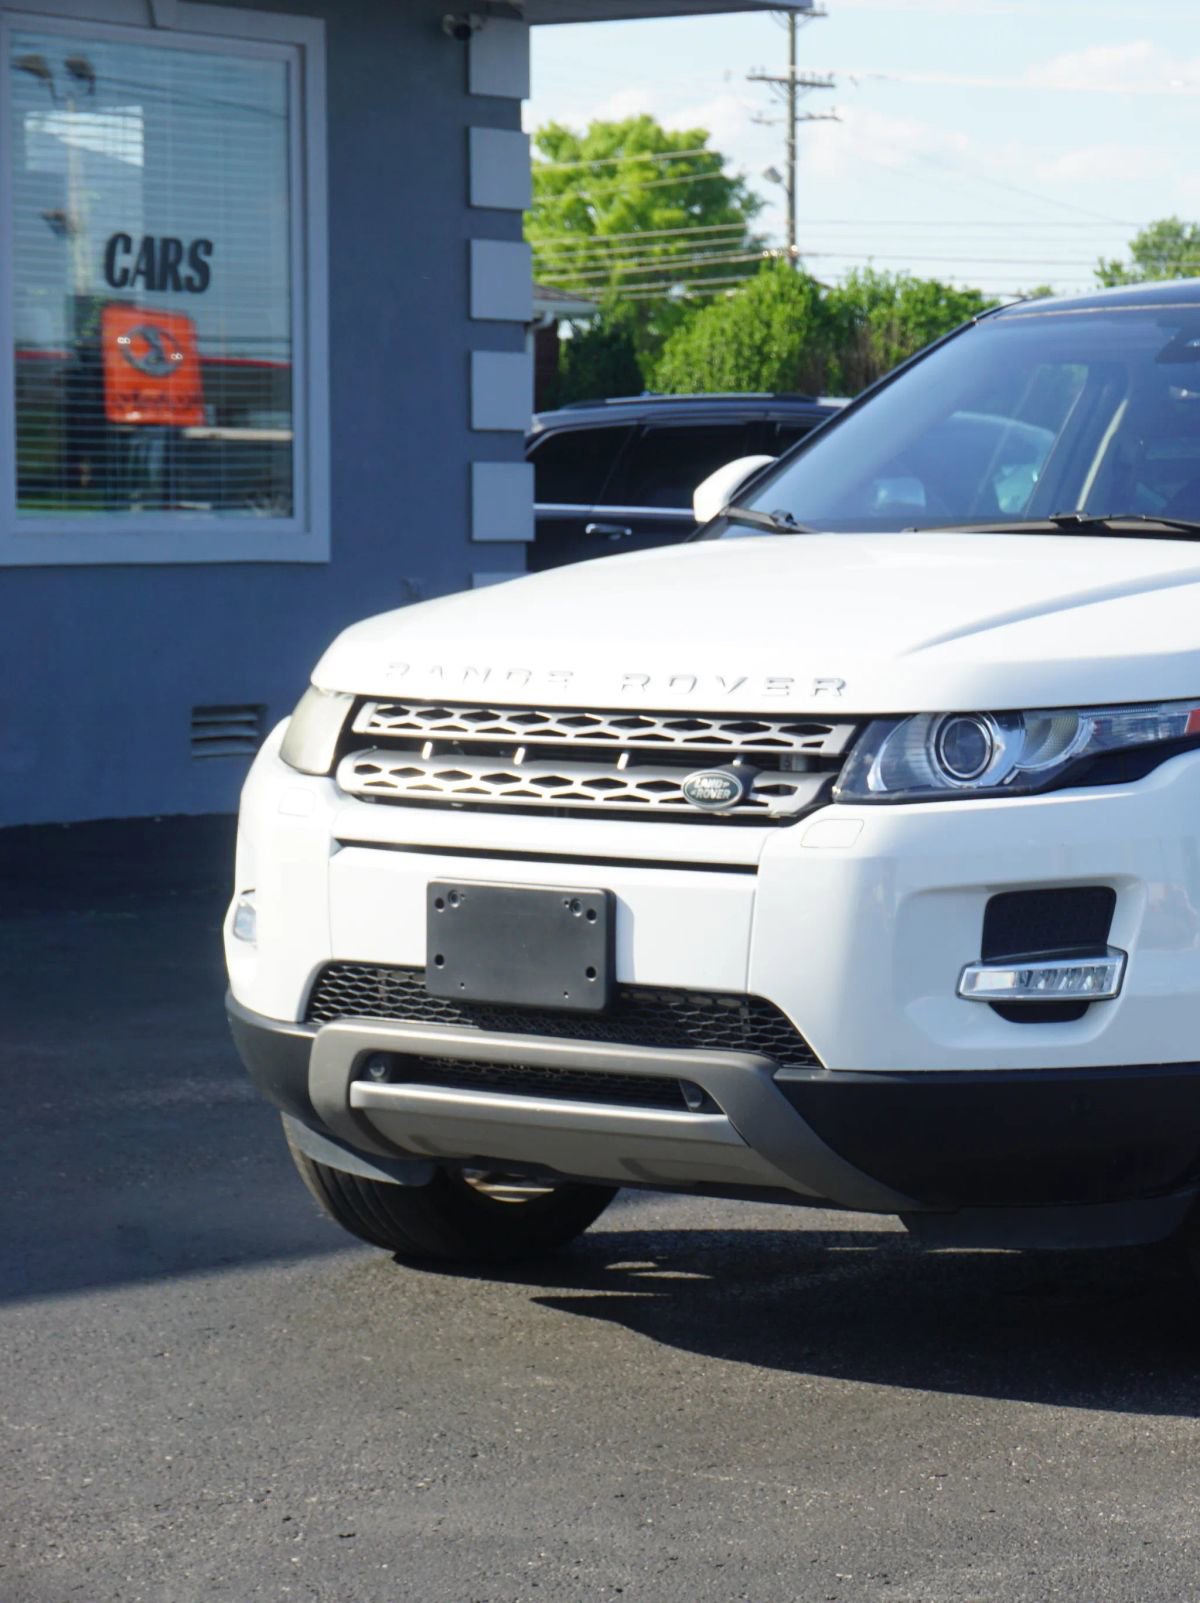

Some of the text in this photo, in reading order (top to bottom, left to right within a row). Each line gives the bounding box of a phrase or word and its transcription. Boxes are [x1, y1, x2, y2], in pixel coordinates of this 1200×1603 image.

[104, 232, 213, 293] CARS
[620, 672, 848, 697] ROVER
[694, 777, 724, 788] LAND
[696, 789, 732, 799] ROVER
